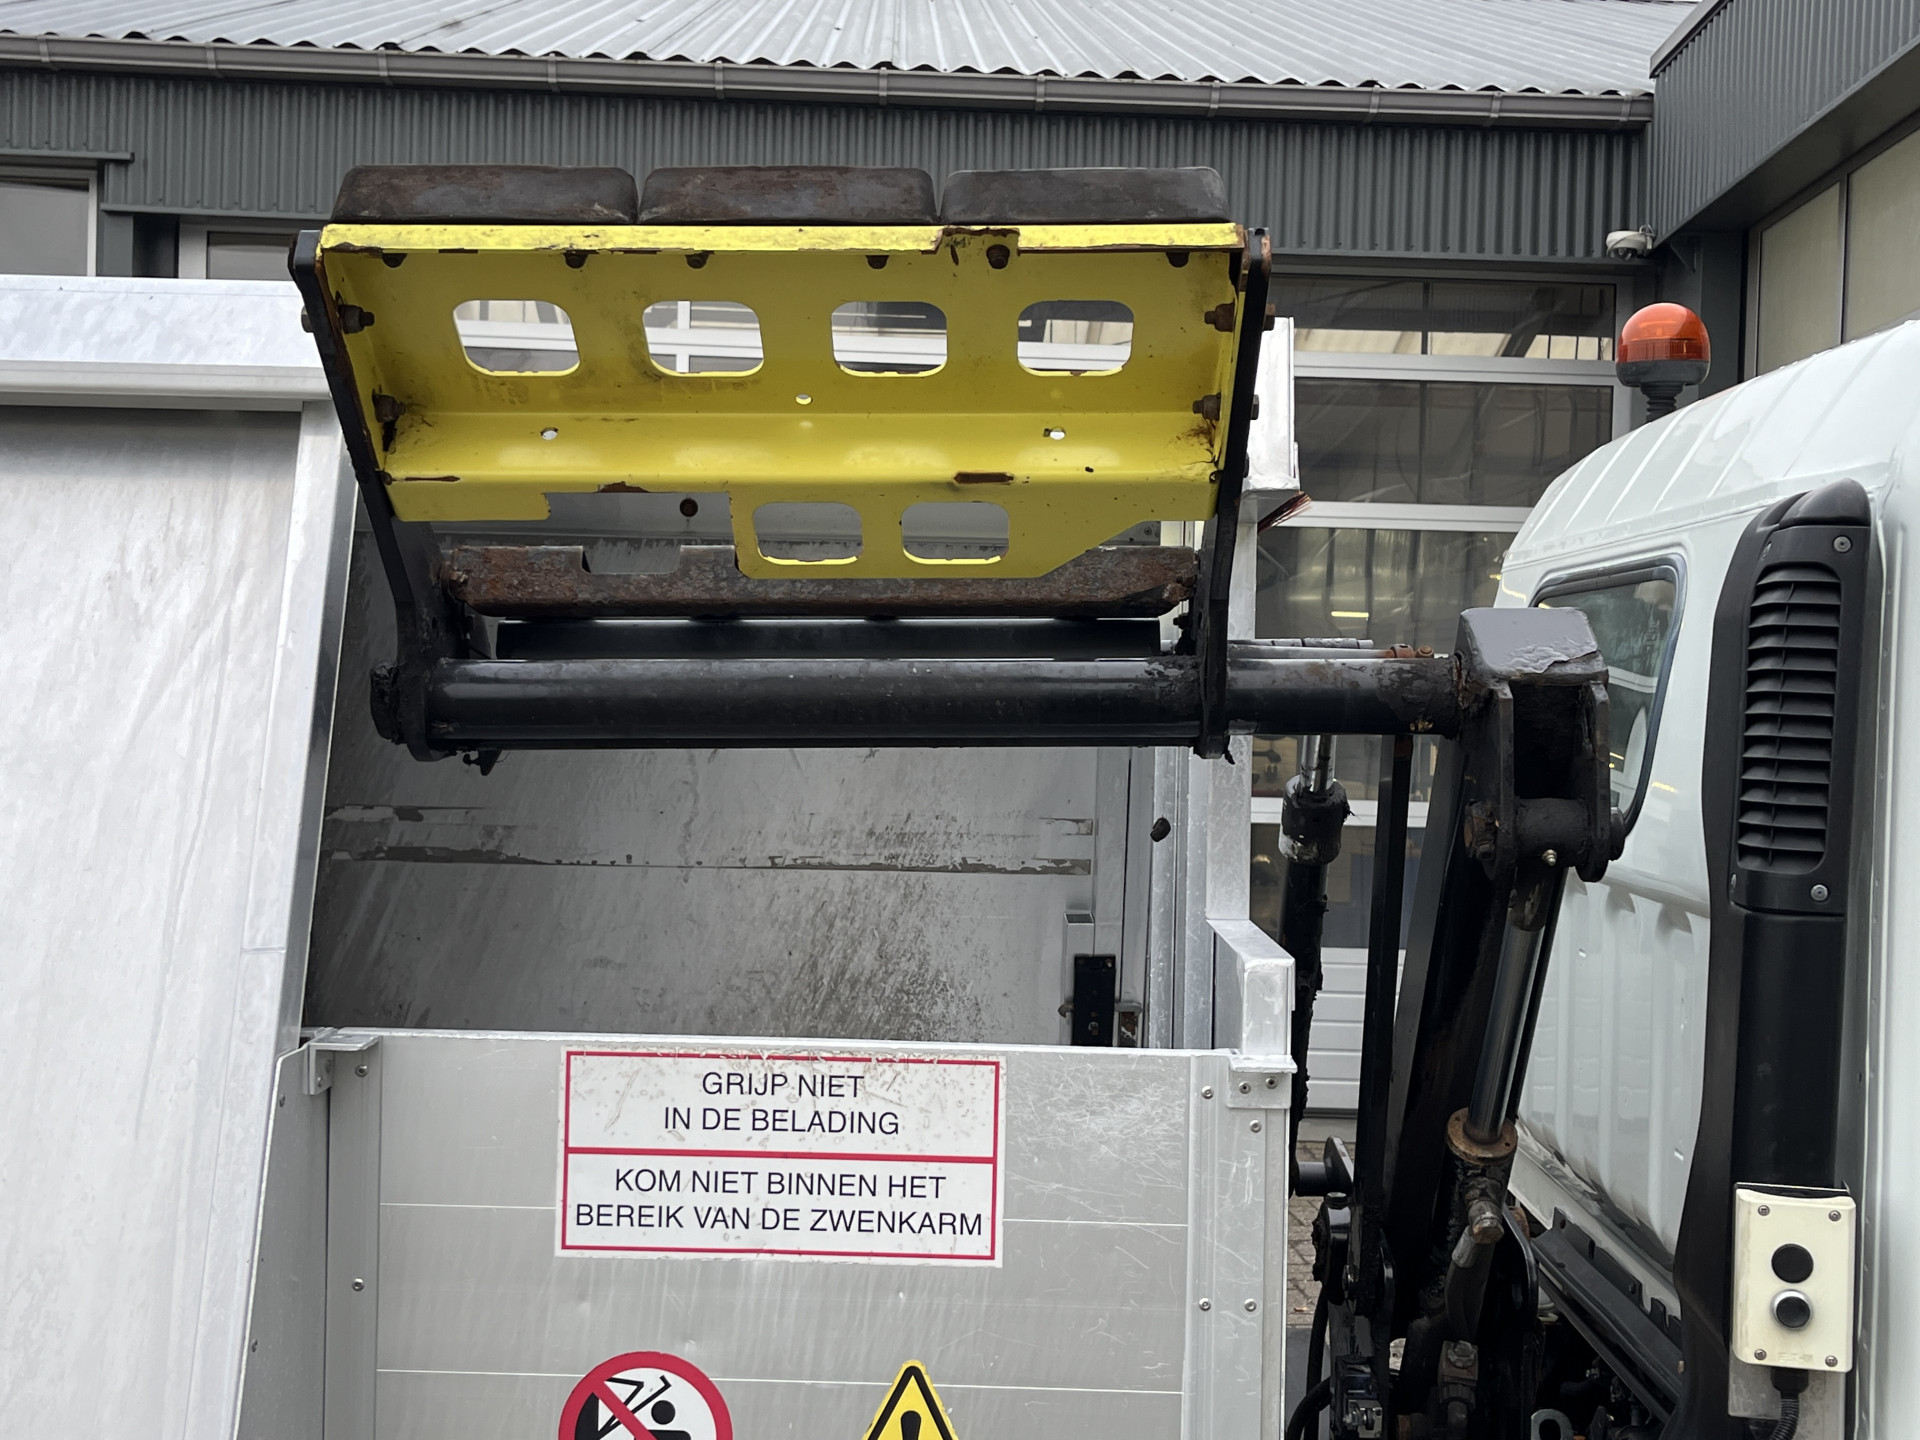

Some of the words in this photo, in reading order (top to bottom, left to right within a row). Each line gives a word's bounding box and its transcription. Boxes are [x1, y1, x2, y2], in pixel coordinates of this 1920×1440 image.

[702, 1071, 788, 1096] GRIJP
[798, 1074, 865, 1099] NIET
[664, 1106, 691, 1130] IN
[702, 1107, 741, 1131] DE
[752, 1109, 899, 1136] BELADING
[615, 1168, 681, 1193] KOM
[692, 1170, 759, 1195] NIET
[767, 1172, 877, 1198] BINNEN
[888, 1175, 947, 1199] HET
[576, 1203, 684, 1229] BEREIK
[693, 1206, 750, 1231] VAN
[761, 1208, 800, 1231] DE
[809, 1209, 983, 1236] ZWENKARM
